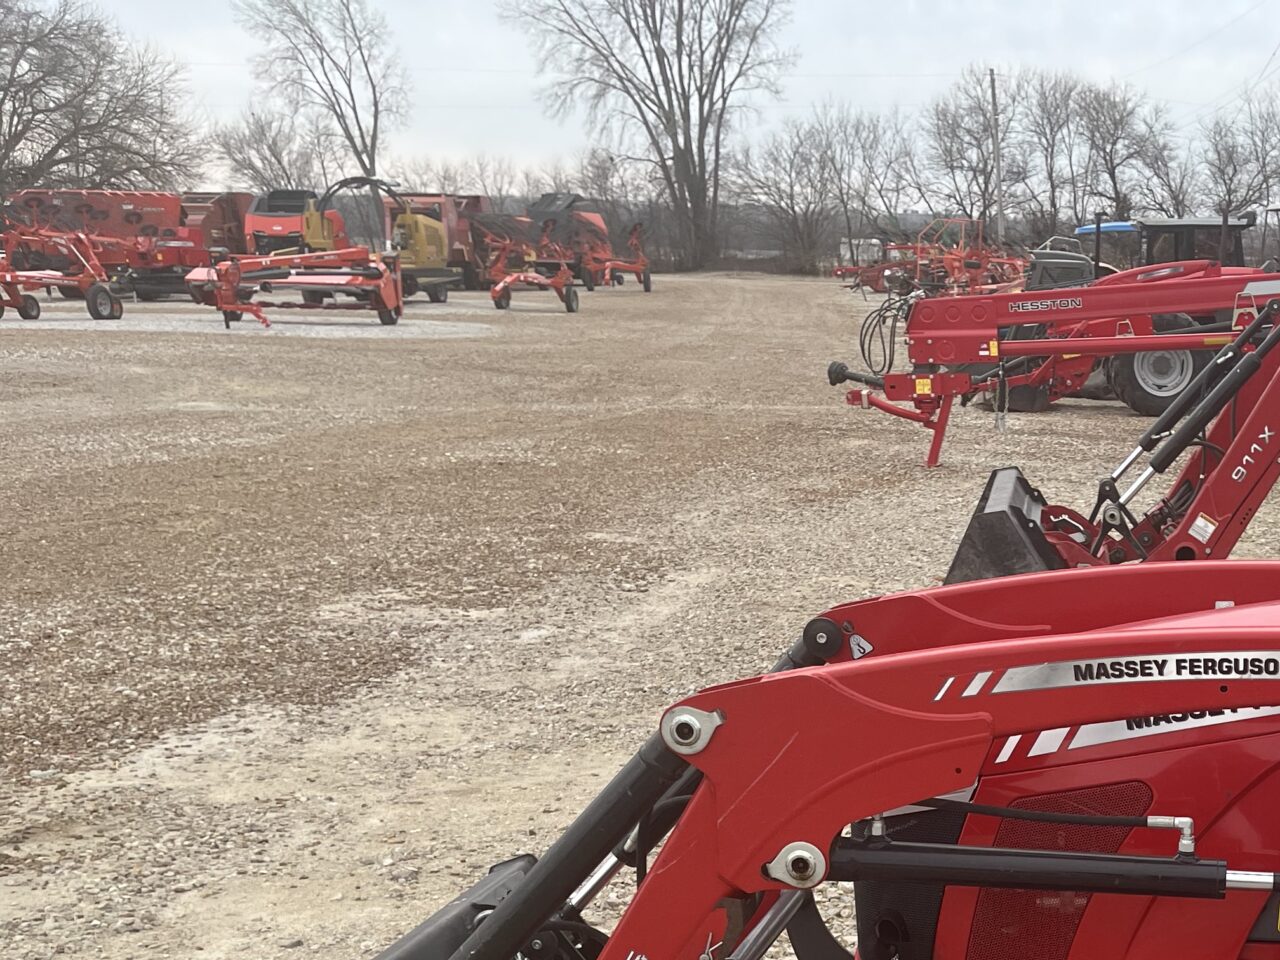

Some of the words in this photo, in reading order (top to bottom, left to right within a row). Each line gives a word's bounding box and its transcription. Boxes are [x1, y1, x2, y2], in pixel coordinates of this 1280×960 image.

[1009, 298, 1083, 312] HESSTON
[1231, 425, 1276, 482] 911X
[1073, 659, 1168, 681] MASSEY
